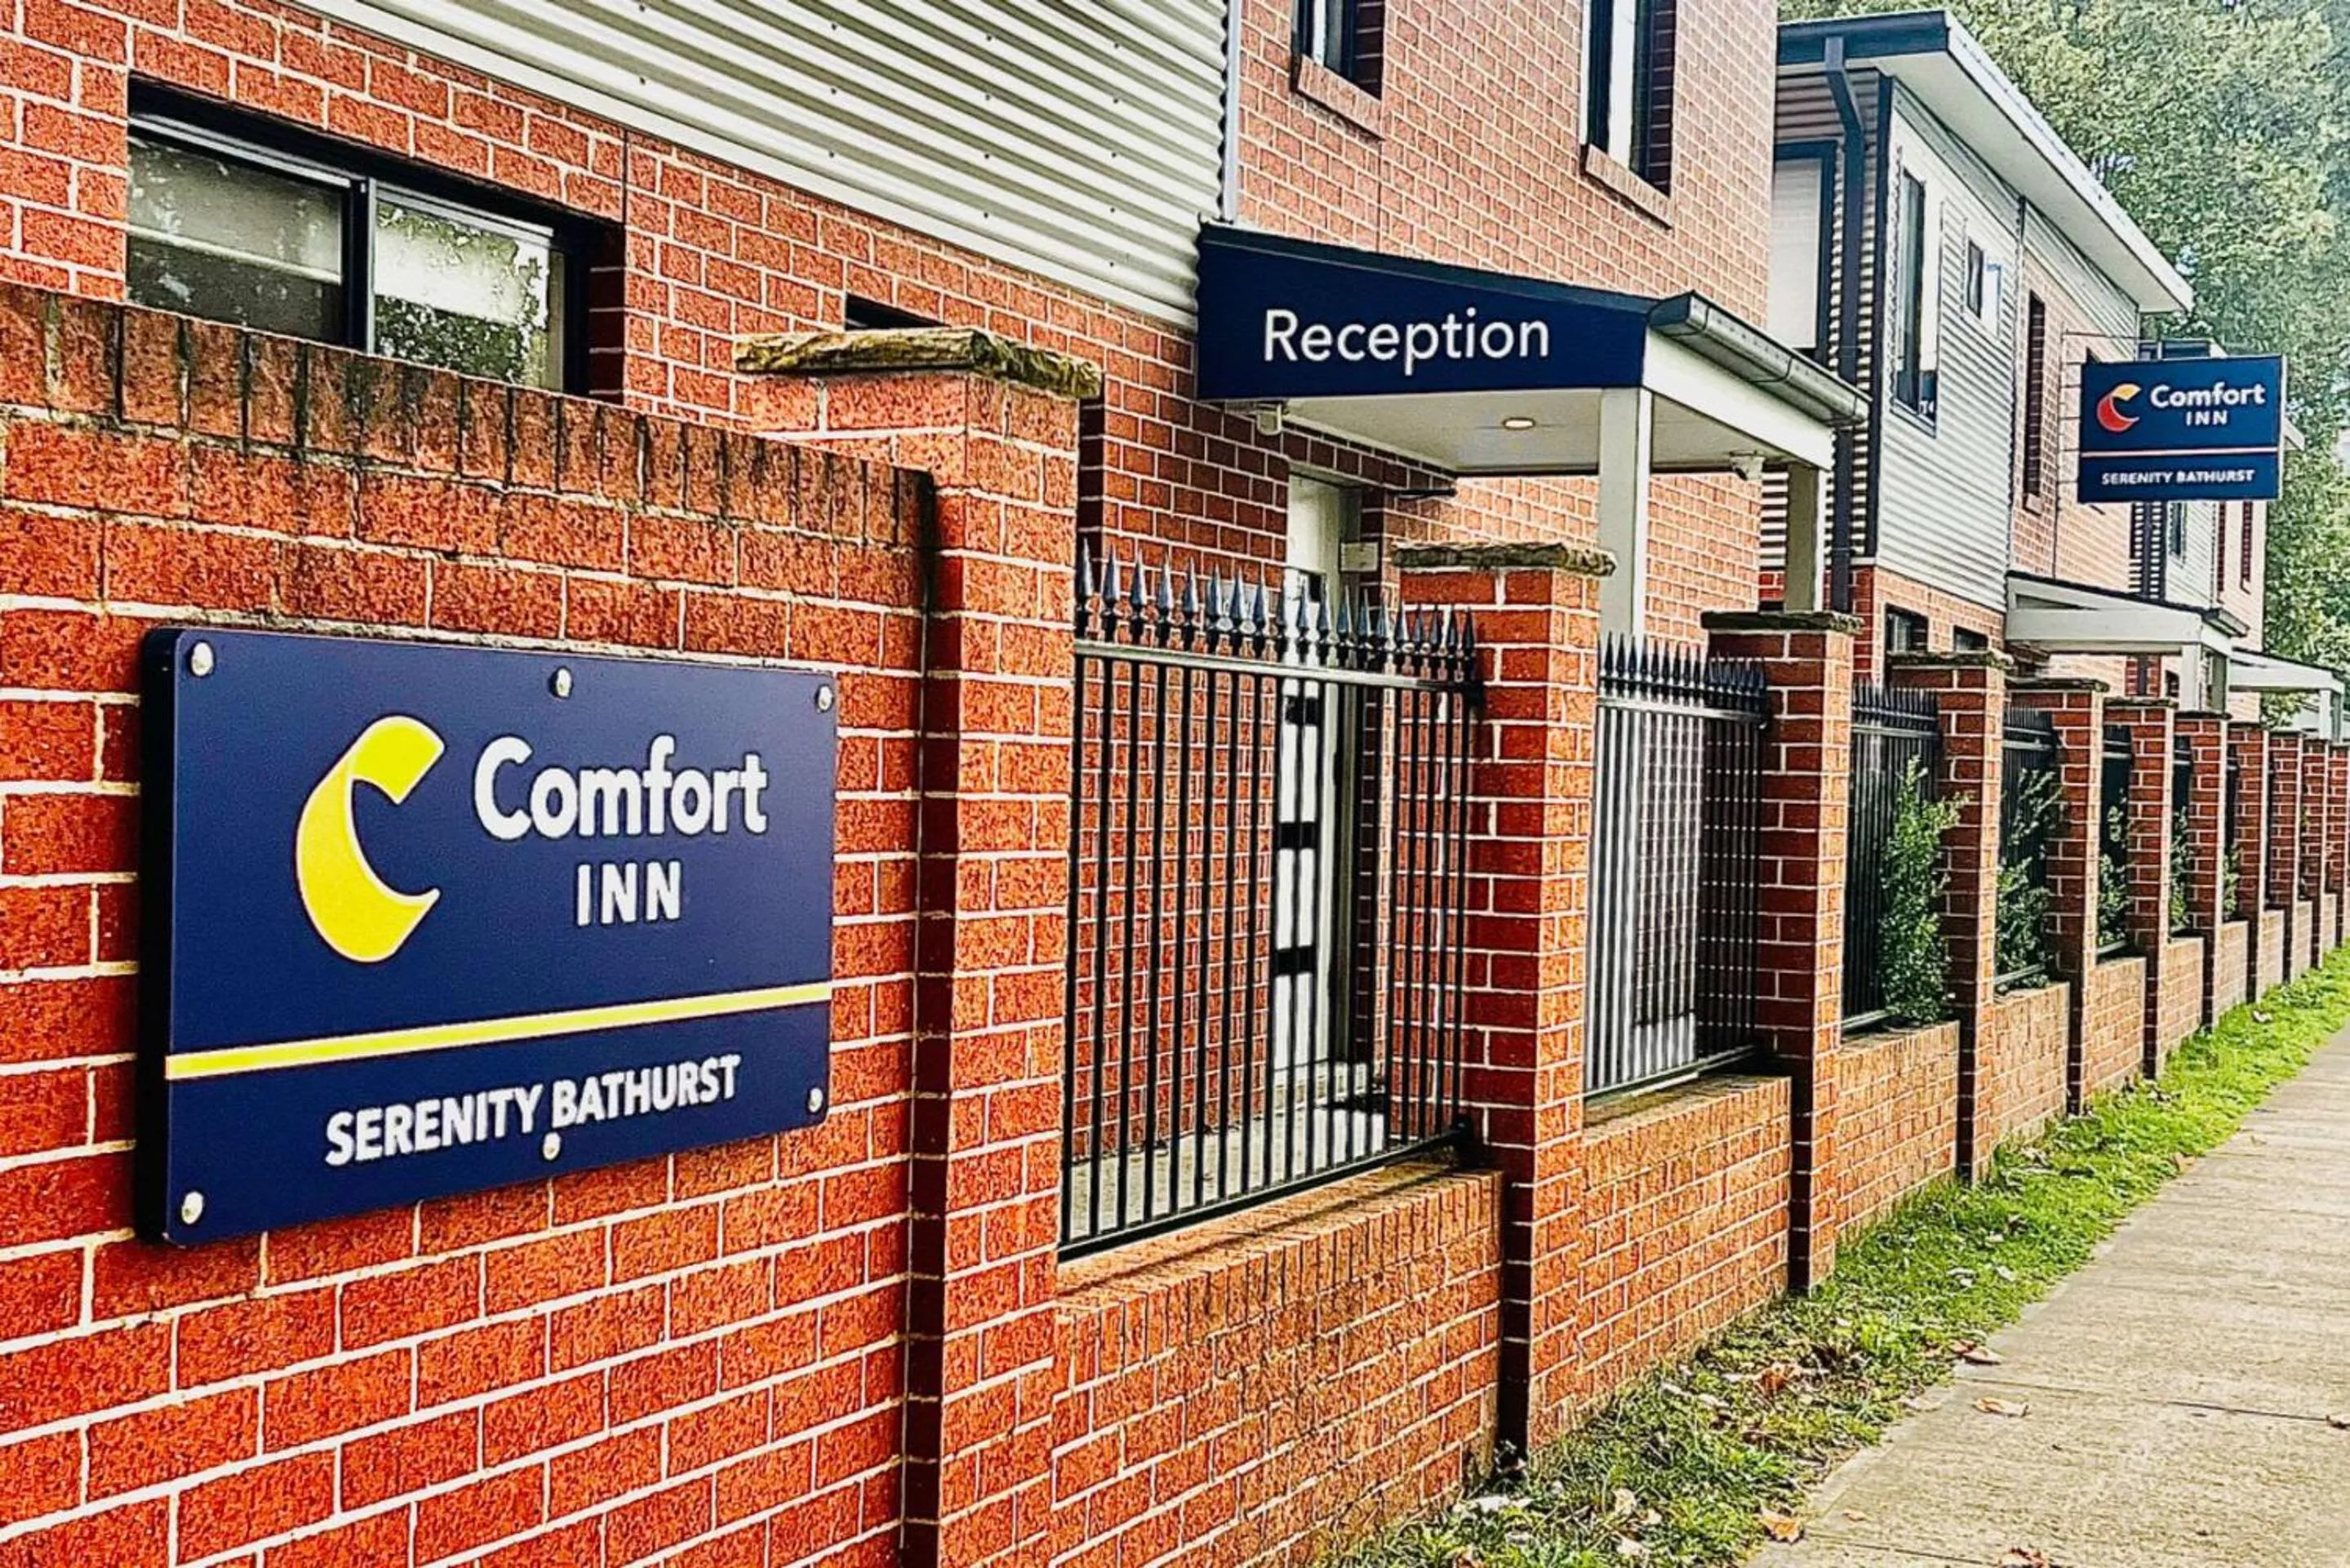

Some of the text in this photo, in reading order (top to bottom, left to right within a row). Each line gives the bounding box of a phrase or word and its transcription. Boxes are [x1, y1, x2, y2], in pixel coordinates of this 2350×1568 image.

[1264, 306, 1549, 376] Reception
[2149, 381, 2266, 408] Comfort
[2185, 410, 2228, 426] INN
[2101, 469, 2255, 486] SERENITY BATHURST
[473, 735, 768, 840] Comfort
[576, 860, 682, 926] INN
[324, 1053, 742, 1167] SERENITY BATHURST
